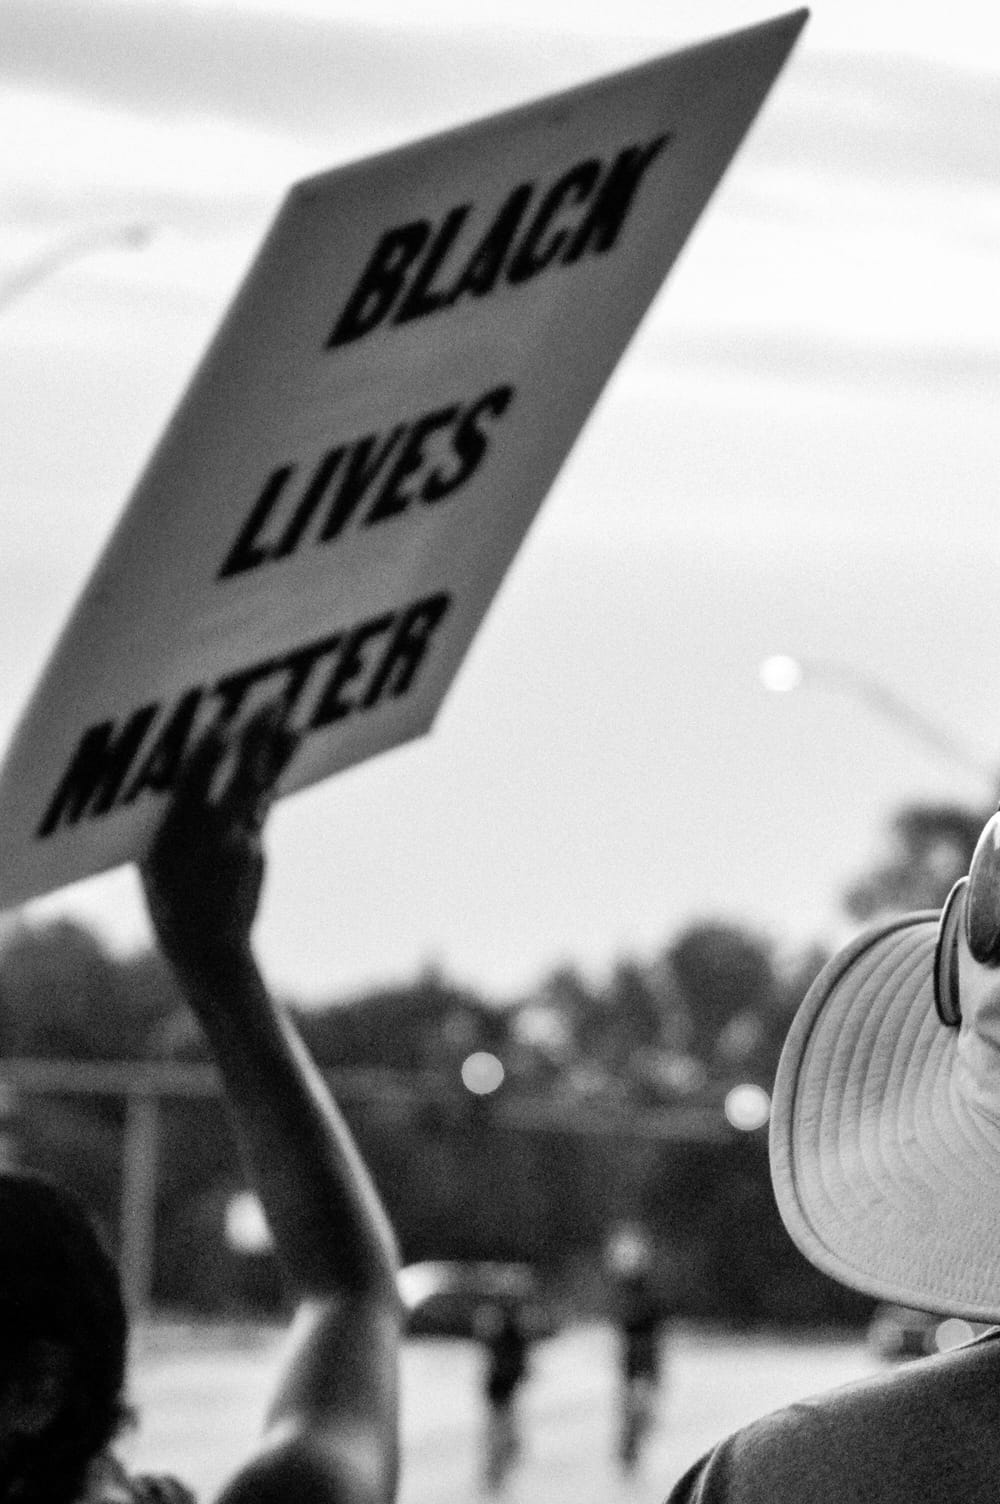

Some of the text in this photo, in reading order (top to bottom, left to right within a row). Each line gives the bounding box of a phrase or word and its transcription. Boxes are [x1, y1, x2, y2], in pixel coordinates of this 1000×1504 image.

[325, 133, 674, 351] BLACK
[216, 384, 514, 580] LIVES
[36, 590, 452, 839] MATTER
